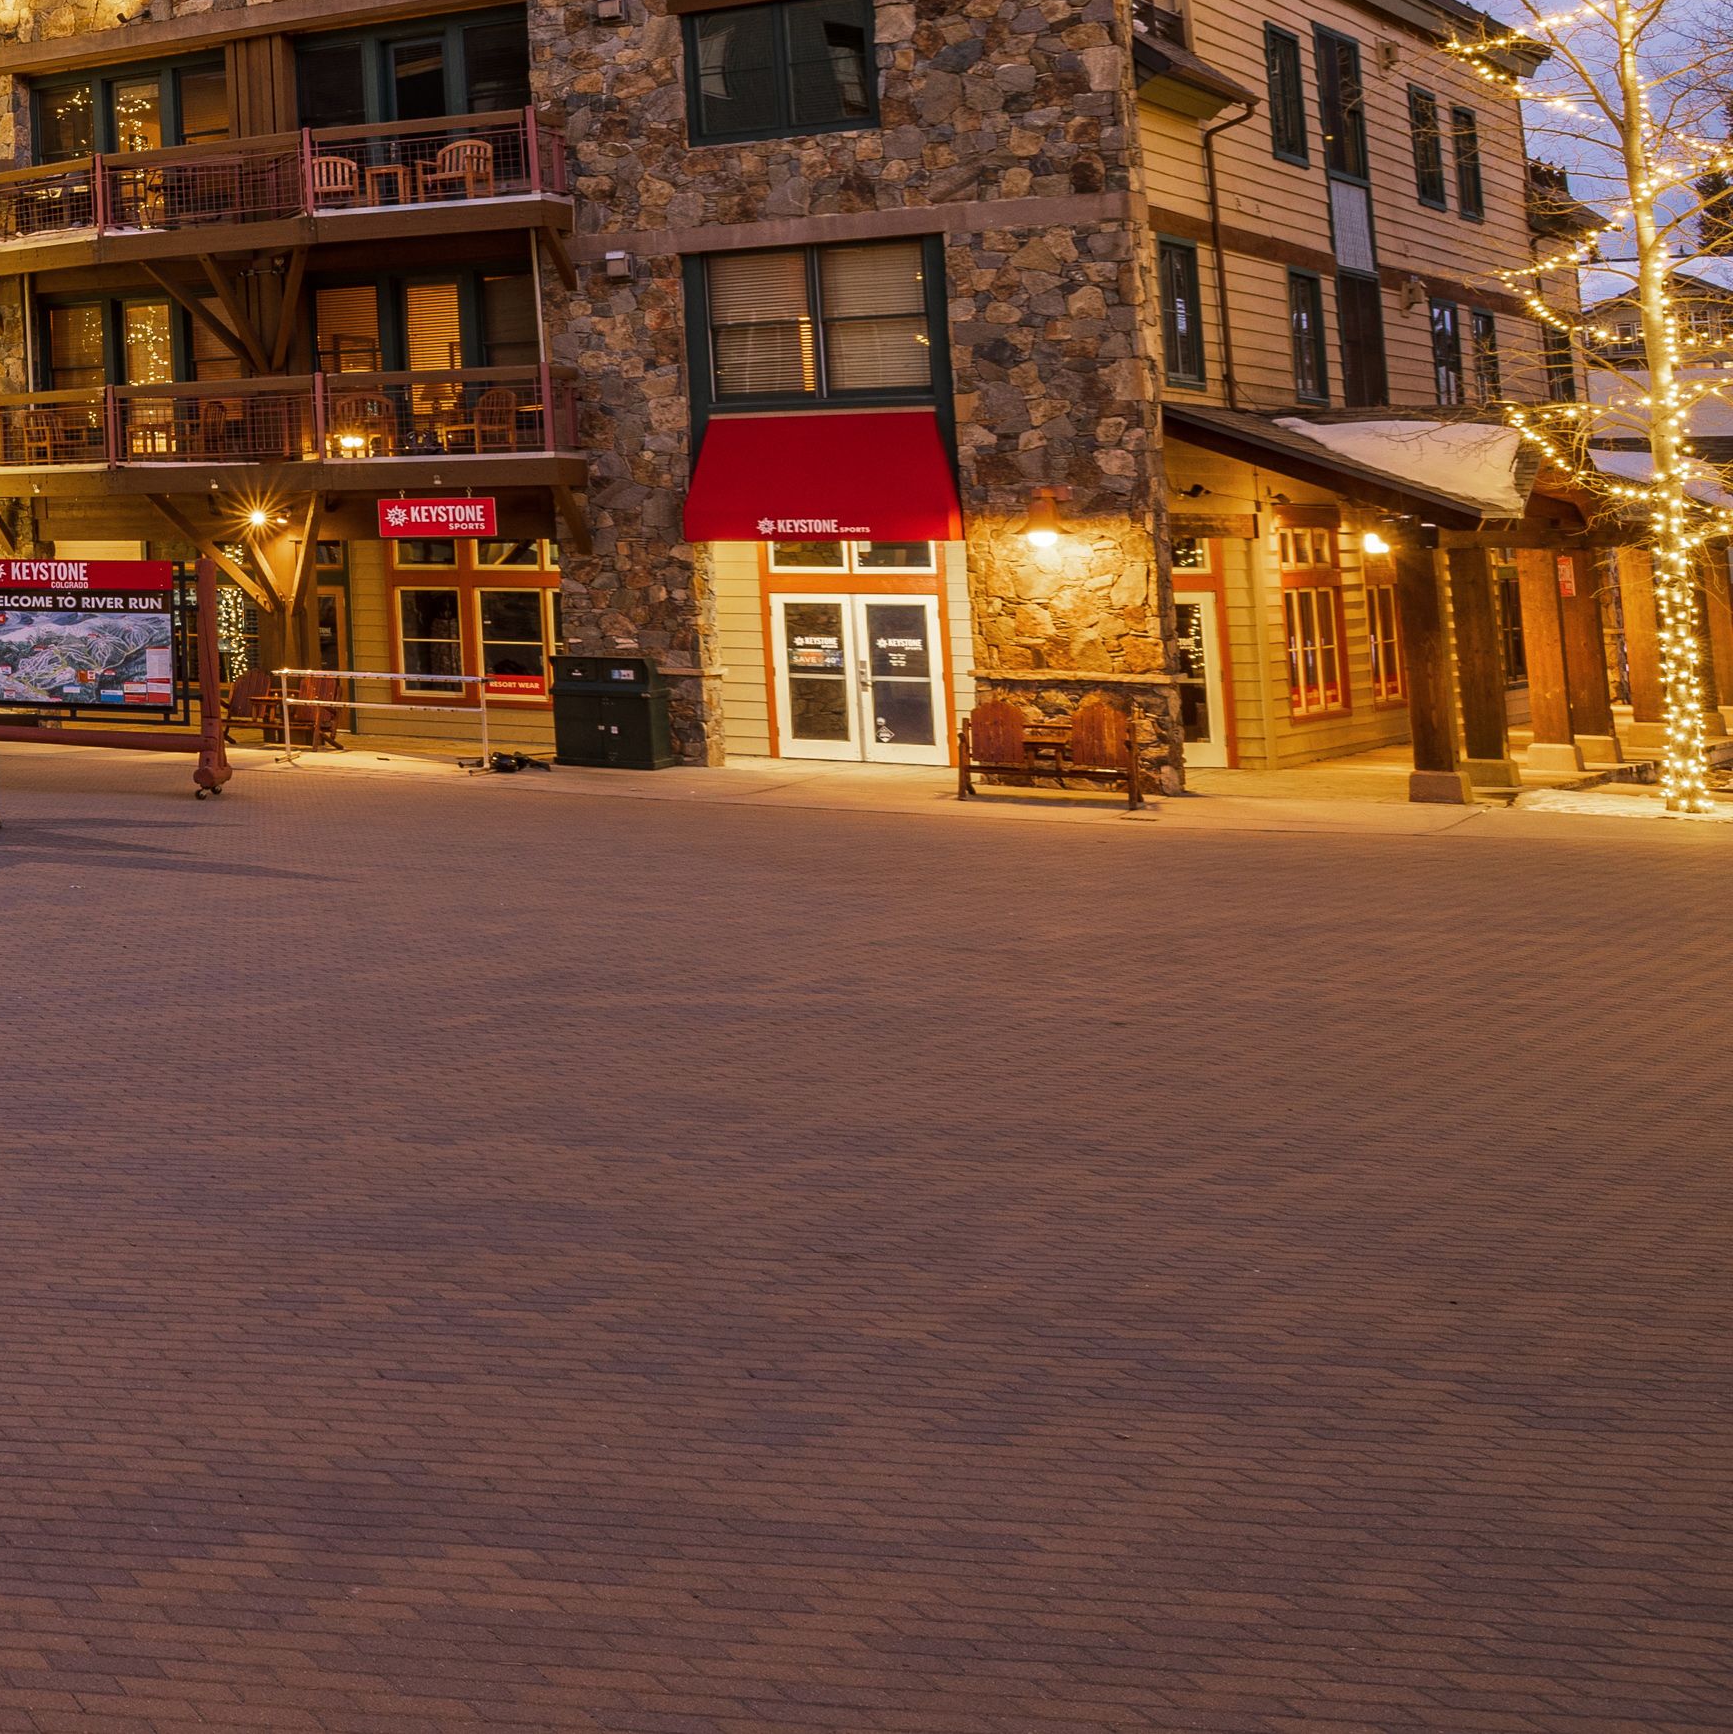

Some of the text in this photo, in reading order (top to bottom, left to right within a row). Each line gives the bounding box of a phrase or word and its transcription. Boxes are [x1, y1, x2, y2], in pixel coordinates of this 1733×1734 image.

[410, 505, 485, 522] KEYSTONE
[776, 519, 838, 533] KEYSTONE
[11, 562, 88, 581] KEYSTONE
[56, 596, 76, 608] TO
[82, 597, 124, 609] RIVER
[128, 598, 162, 610] RUN
[804, 636, 838, 645] KEYSTONE
[888, 638, 922, 647] KEYSTONE
[489, 680, 516, 689] RESORT
